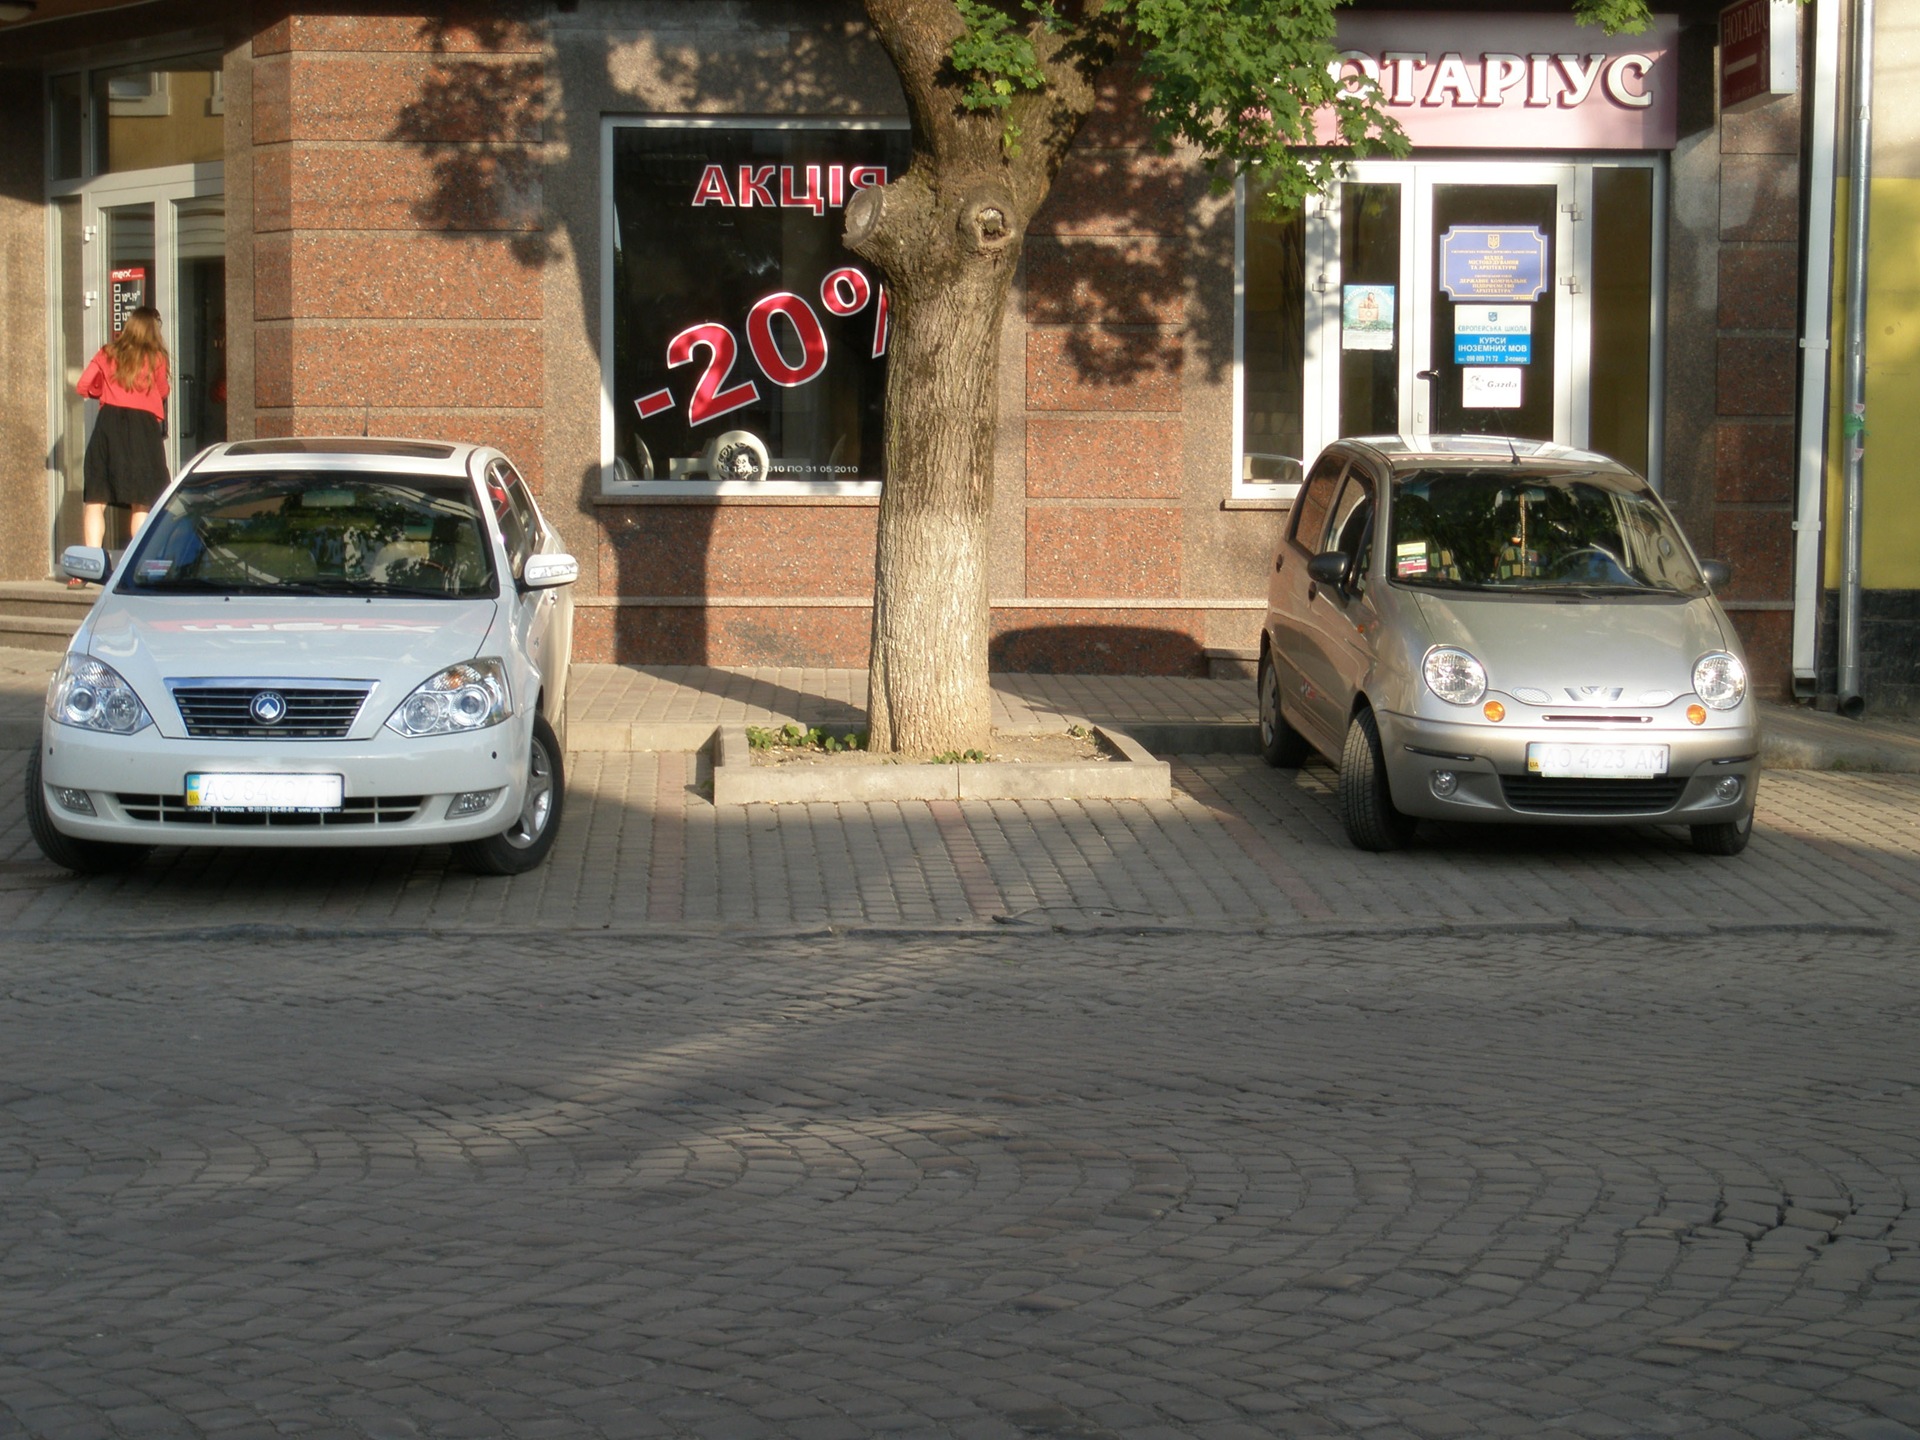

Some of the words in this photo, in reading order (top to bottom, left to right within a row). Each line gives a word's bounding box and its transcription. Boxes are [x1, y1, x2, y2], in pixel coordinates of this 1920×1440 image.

[1326, 49, 1655, 111] ОТАРІУС
[692, 164, 888, 217] АКЦІЯ
[805, 465, 817, 473] 31
[820, 465, 832, 473] 05
[835, 465, 858, 473] 2010
[1635, 749, 1664, 770] AM
[203, 780, 234, 801] AO
